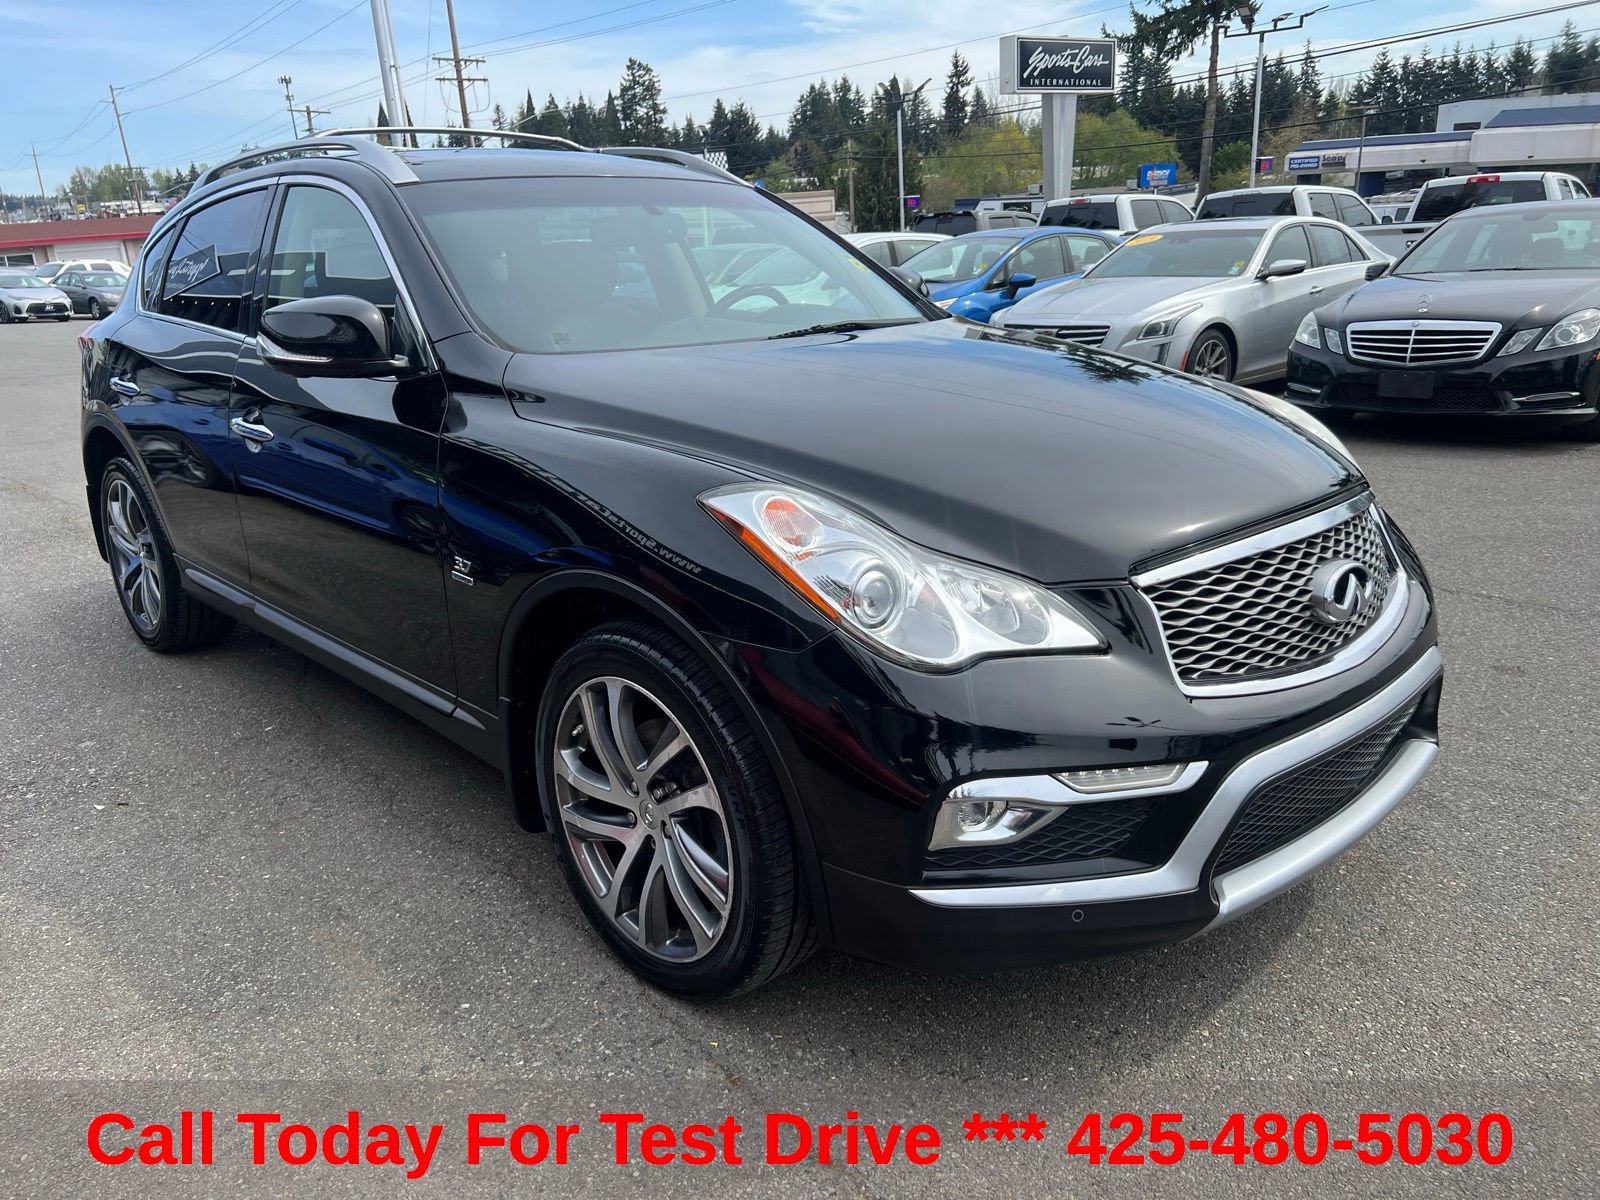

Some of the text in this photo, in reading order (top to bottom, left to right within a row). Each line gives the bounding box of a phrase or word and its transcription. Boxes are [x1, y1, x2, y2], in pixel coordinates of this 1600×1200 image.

[1023, 45, 1109, 78] Sports Cars
[1030, 78, 1102, 86] INTERNATIONAL
